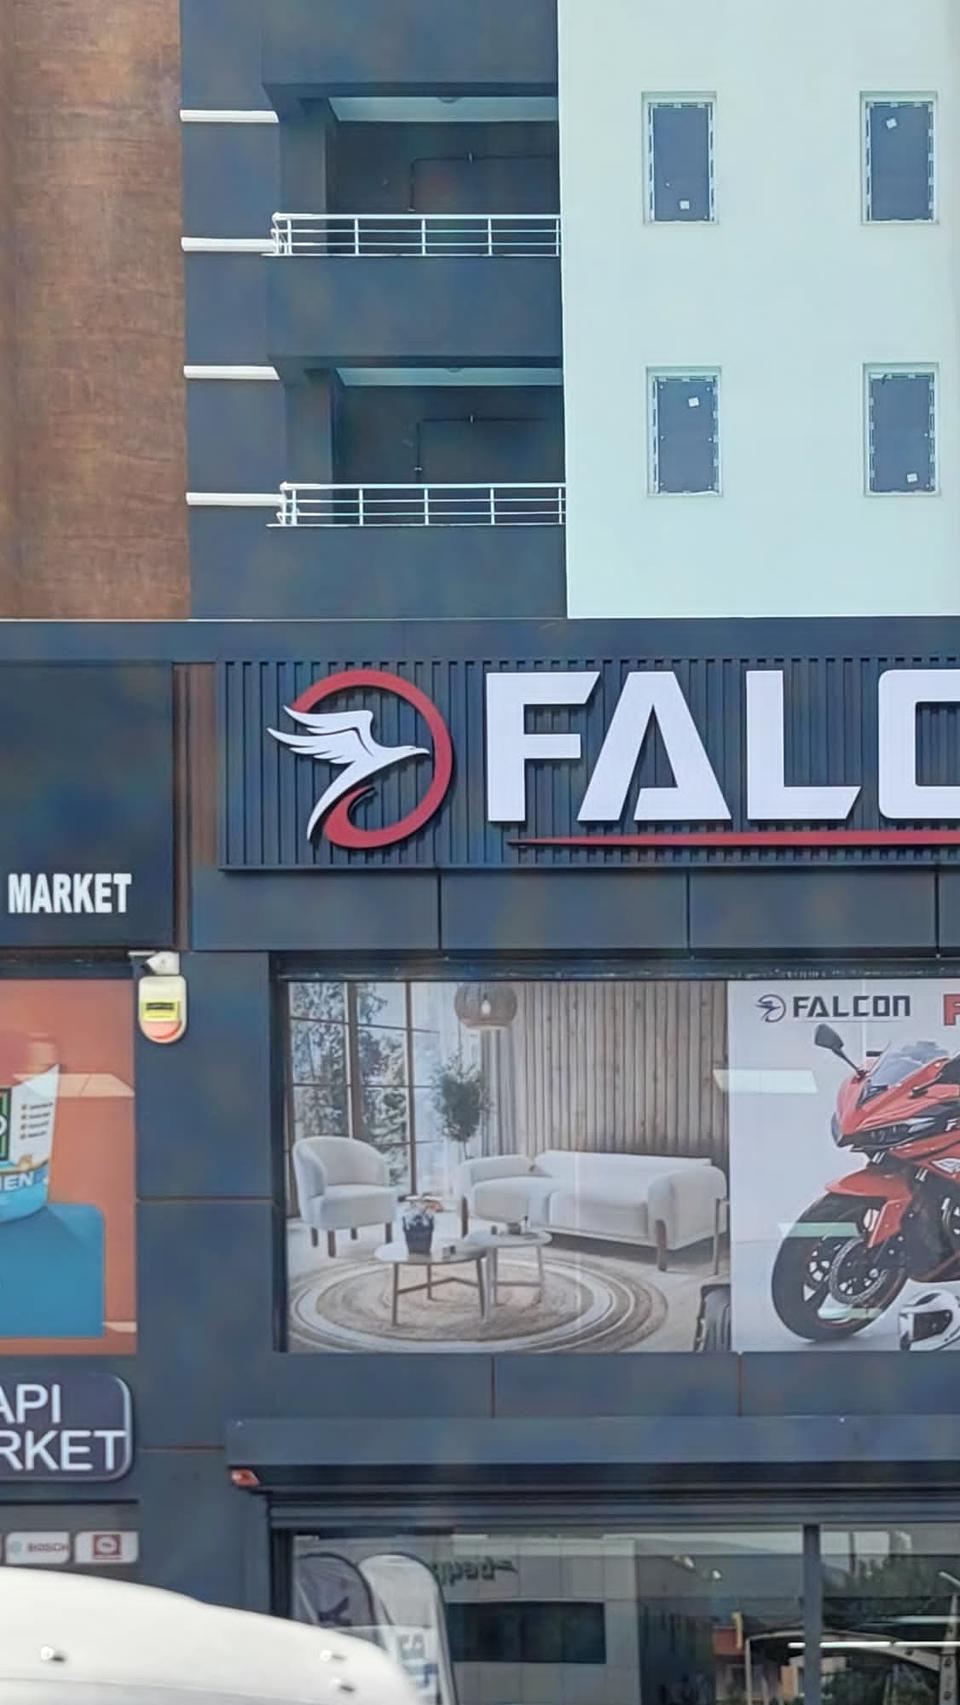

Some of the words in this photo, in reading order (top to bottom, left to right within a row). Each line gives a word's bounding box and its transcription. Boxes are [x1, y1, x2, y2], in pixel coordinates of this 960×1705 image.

[8, 873, 132, 913] MARKET
[793, 995, 910, 1018] FALCON
[0, 1172, 34, 1191] EN
